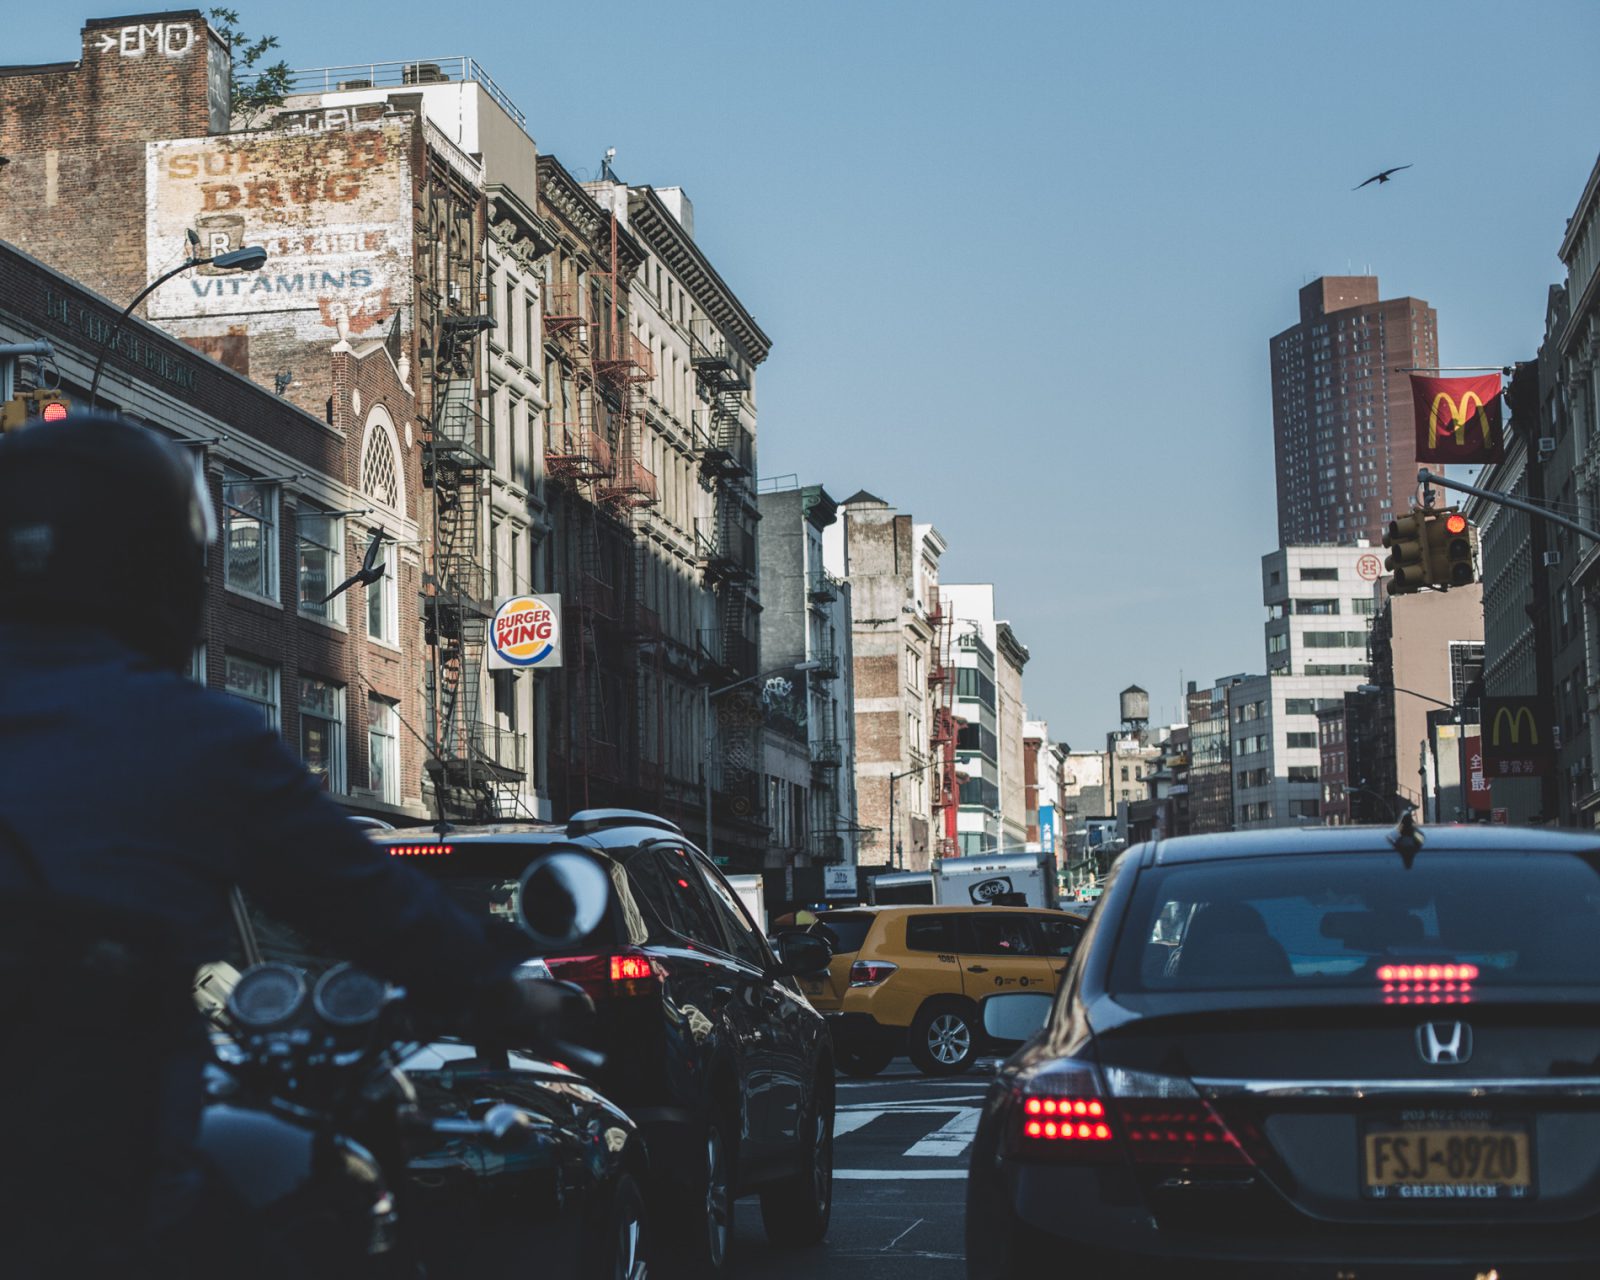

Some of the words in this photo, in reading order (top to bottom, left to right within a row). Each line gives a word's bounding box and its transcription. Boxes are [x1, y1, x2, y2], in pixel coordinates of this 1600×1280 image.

[200, 173, 361, 212] DRUG
[190, 269, 374, 298] VITAMINS
[497, 610, 551, 632] BURGER
[498, 622, 552, 649] KING
[1399, 1185, 1498, 1198] GREENWICH
